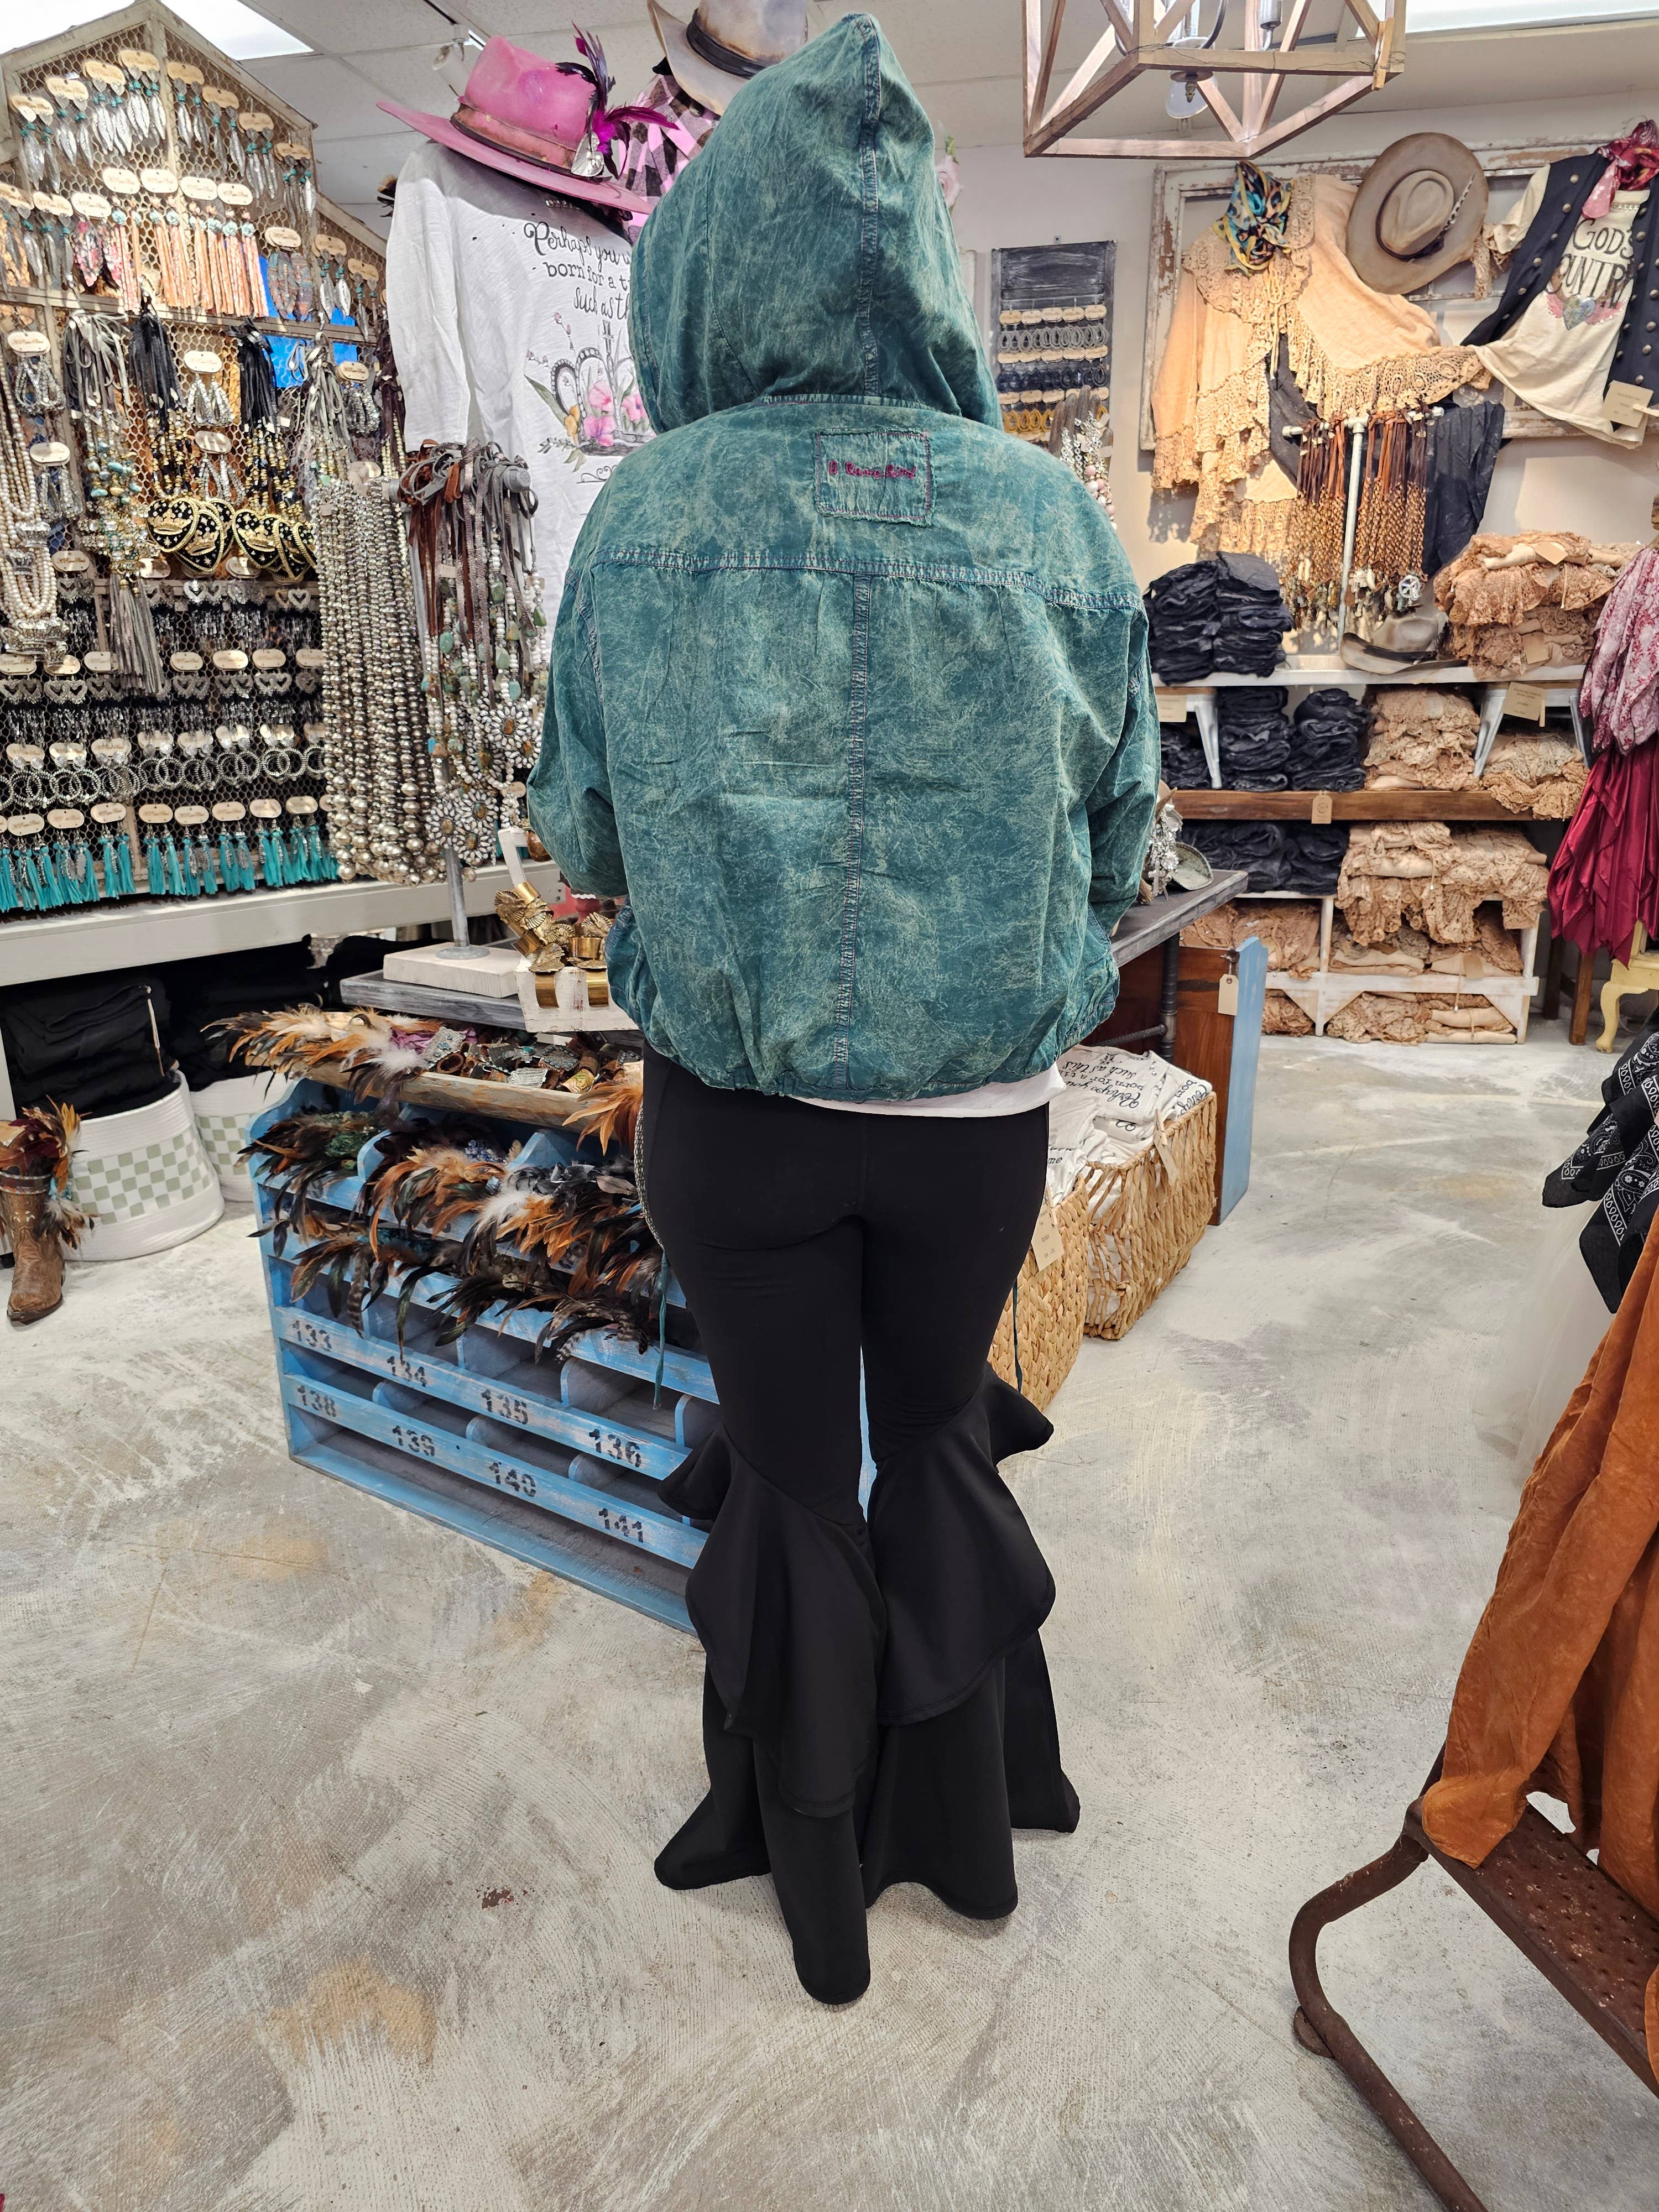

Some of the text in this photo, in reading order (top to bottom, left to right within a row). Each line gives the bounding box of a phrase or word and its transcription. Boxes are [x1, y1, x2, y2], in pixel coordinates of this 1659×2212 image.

[524, 221, 592, 265] Perhaps
[595, 246, 620, 273] you
[542, 262, 585, 279] born
[587, 265, 604, 286] for
[608, 276, 617, 289] a
[601, 297, 613, 319] as
[828, 460, 838, 475] A
[1062, 1061, 1090, 1073] this
[1090, 1076, 1112, 1084] for
[1105, 1066, 1136, 1079] such
[291, 1320, 332, 1352] 133
[387, 1355, 427, 1387] 134
[298, 1385, 336, 1417] 138
[481, 1389, 528, 1425] 135
[392, 1425, 435, 1456] 139
[588, 1428, 641, 1468] 136
[489, 1462, 536, 1497] 140
[598, 1507, 644, 1543] 141
